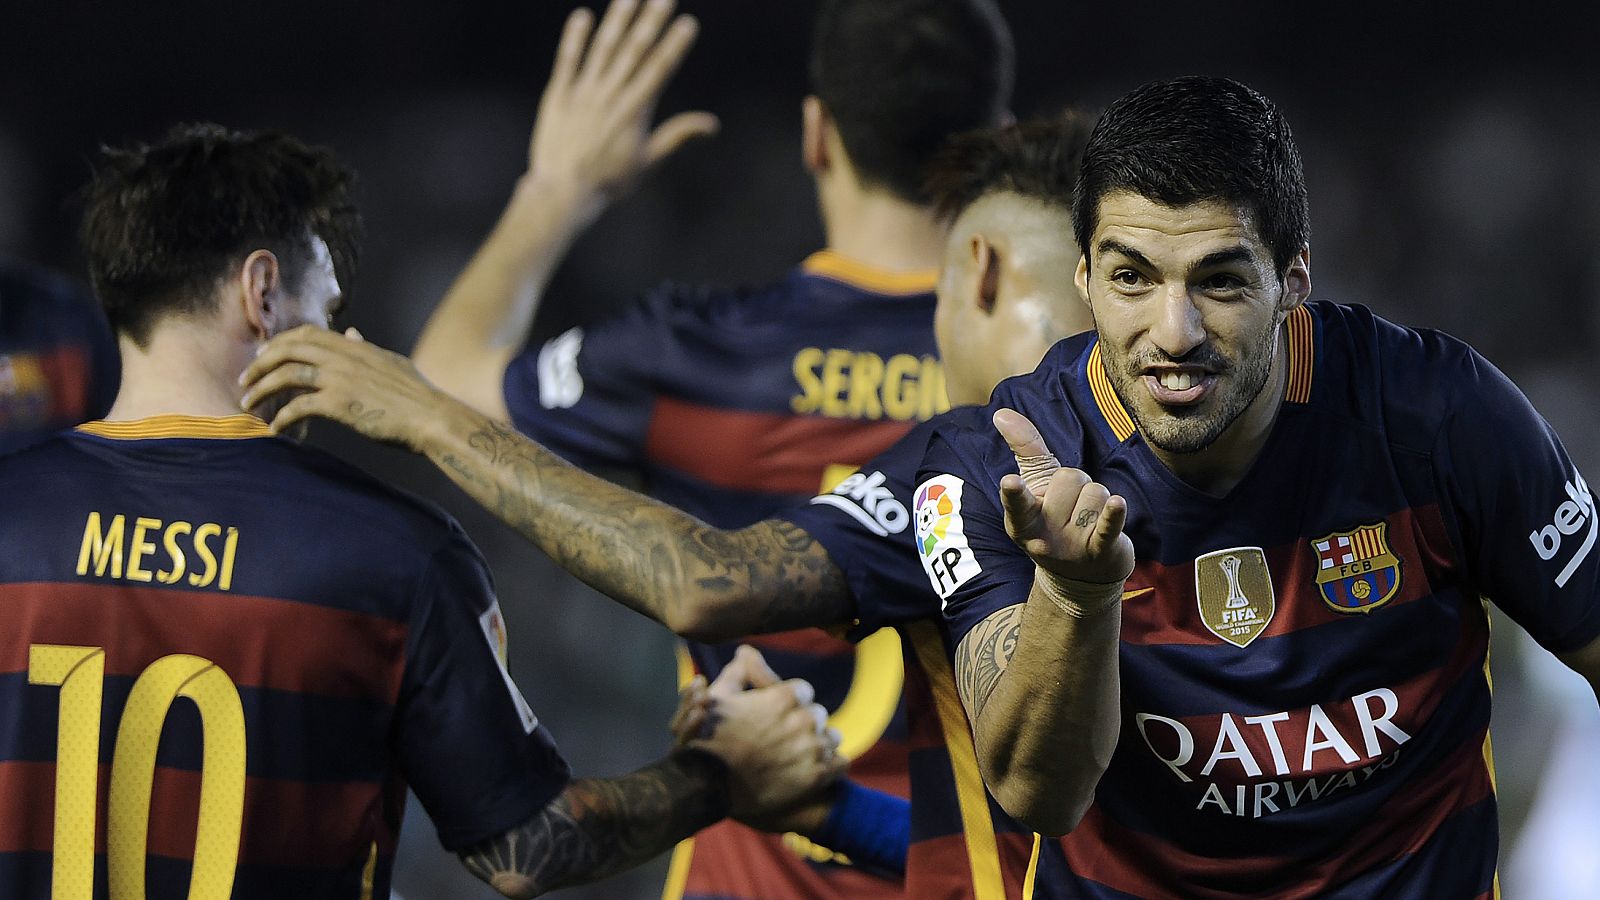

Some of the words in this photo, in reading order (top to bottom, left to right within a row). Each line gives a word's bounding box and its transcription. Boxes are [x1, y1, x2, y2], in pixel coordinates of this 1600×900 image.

[832, 470, 910, 534] eko
[76, 511, 239, 591] MESSI
[931, 547, 962, 595] FP
[1222, 607, 1257, 623] FIFA
[1230, 625, 1251, 636] 2015
[1135, 687, 1412, 783] QATAR
[28, 643, 247, 900] 10
